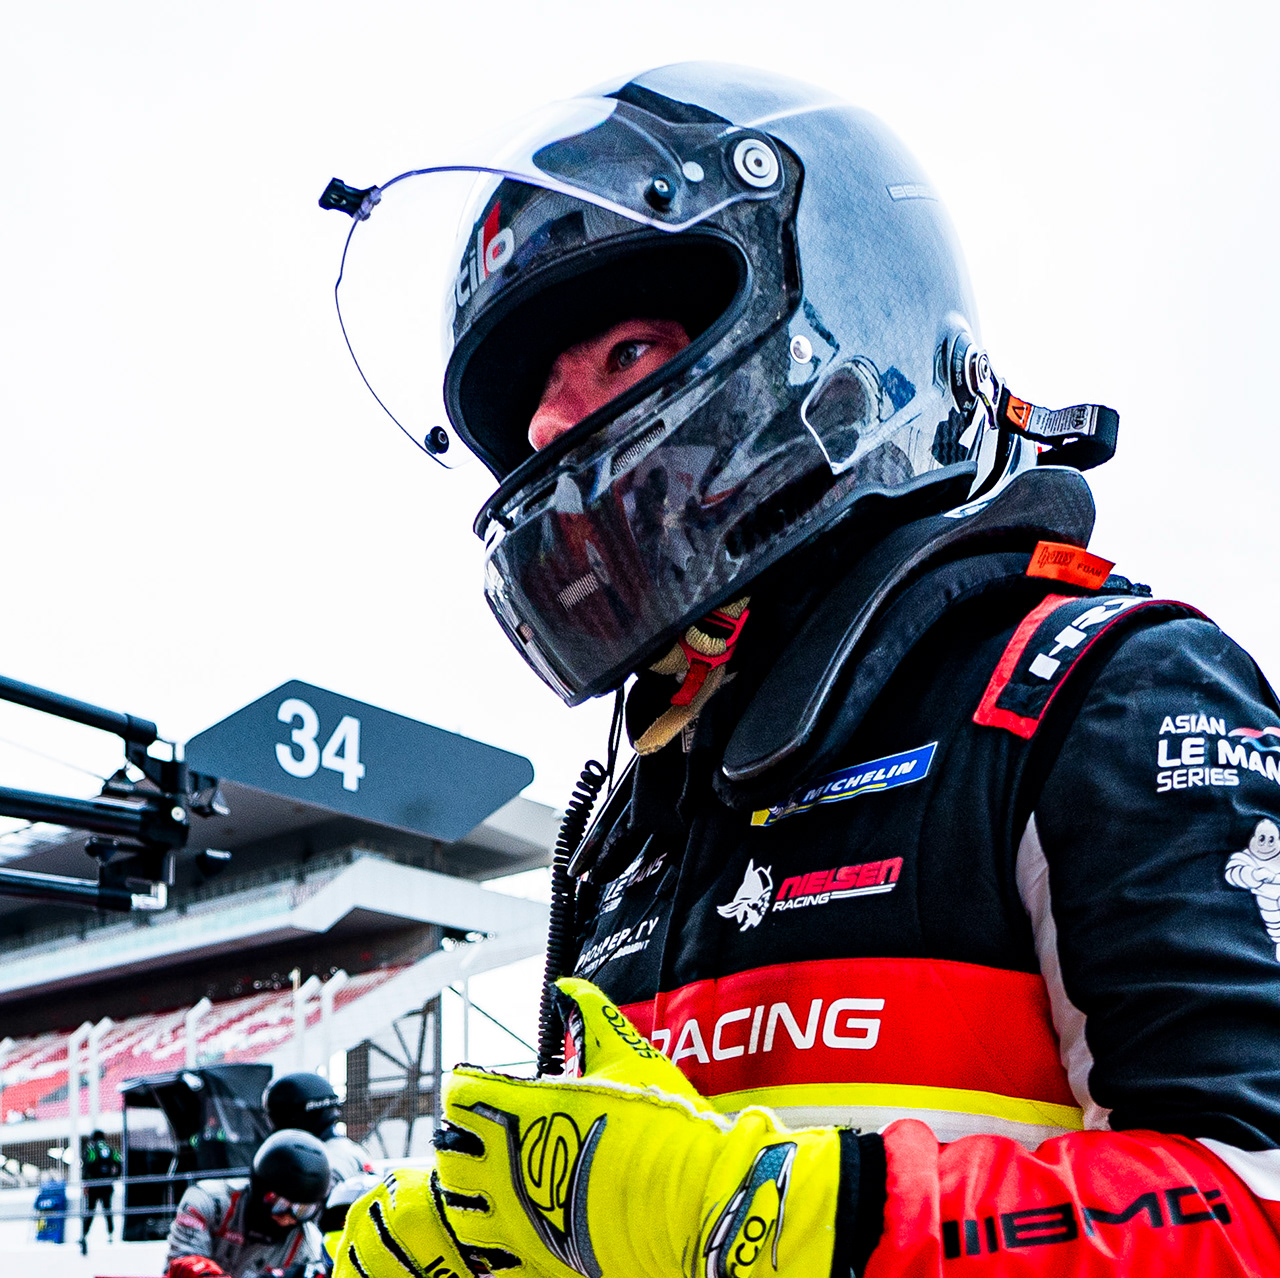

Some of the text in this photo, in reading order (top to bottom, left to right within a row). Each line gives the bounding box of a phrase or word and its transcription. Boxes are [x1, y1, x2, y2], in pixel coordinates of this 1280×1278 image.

[455, 224, 515, 307] tilo
[1076, 562, 1104, 577] FOAM
[1158, 713, 1227, 736] ASIAN
[275, 697, 367, 792] 34
[1157, 737, 1206, 768] LE
[802, 759, 918, 803] MICHELIN
[1156, 767, 1240, 793] SERIES
[775, 857, 904, 900] NIELSEN
[772, 893, 831, 912] RACING
[574, 916, 660, 973] PROSPERTY
